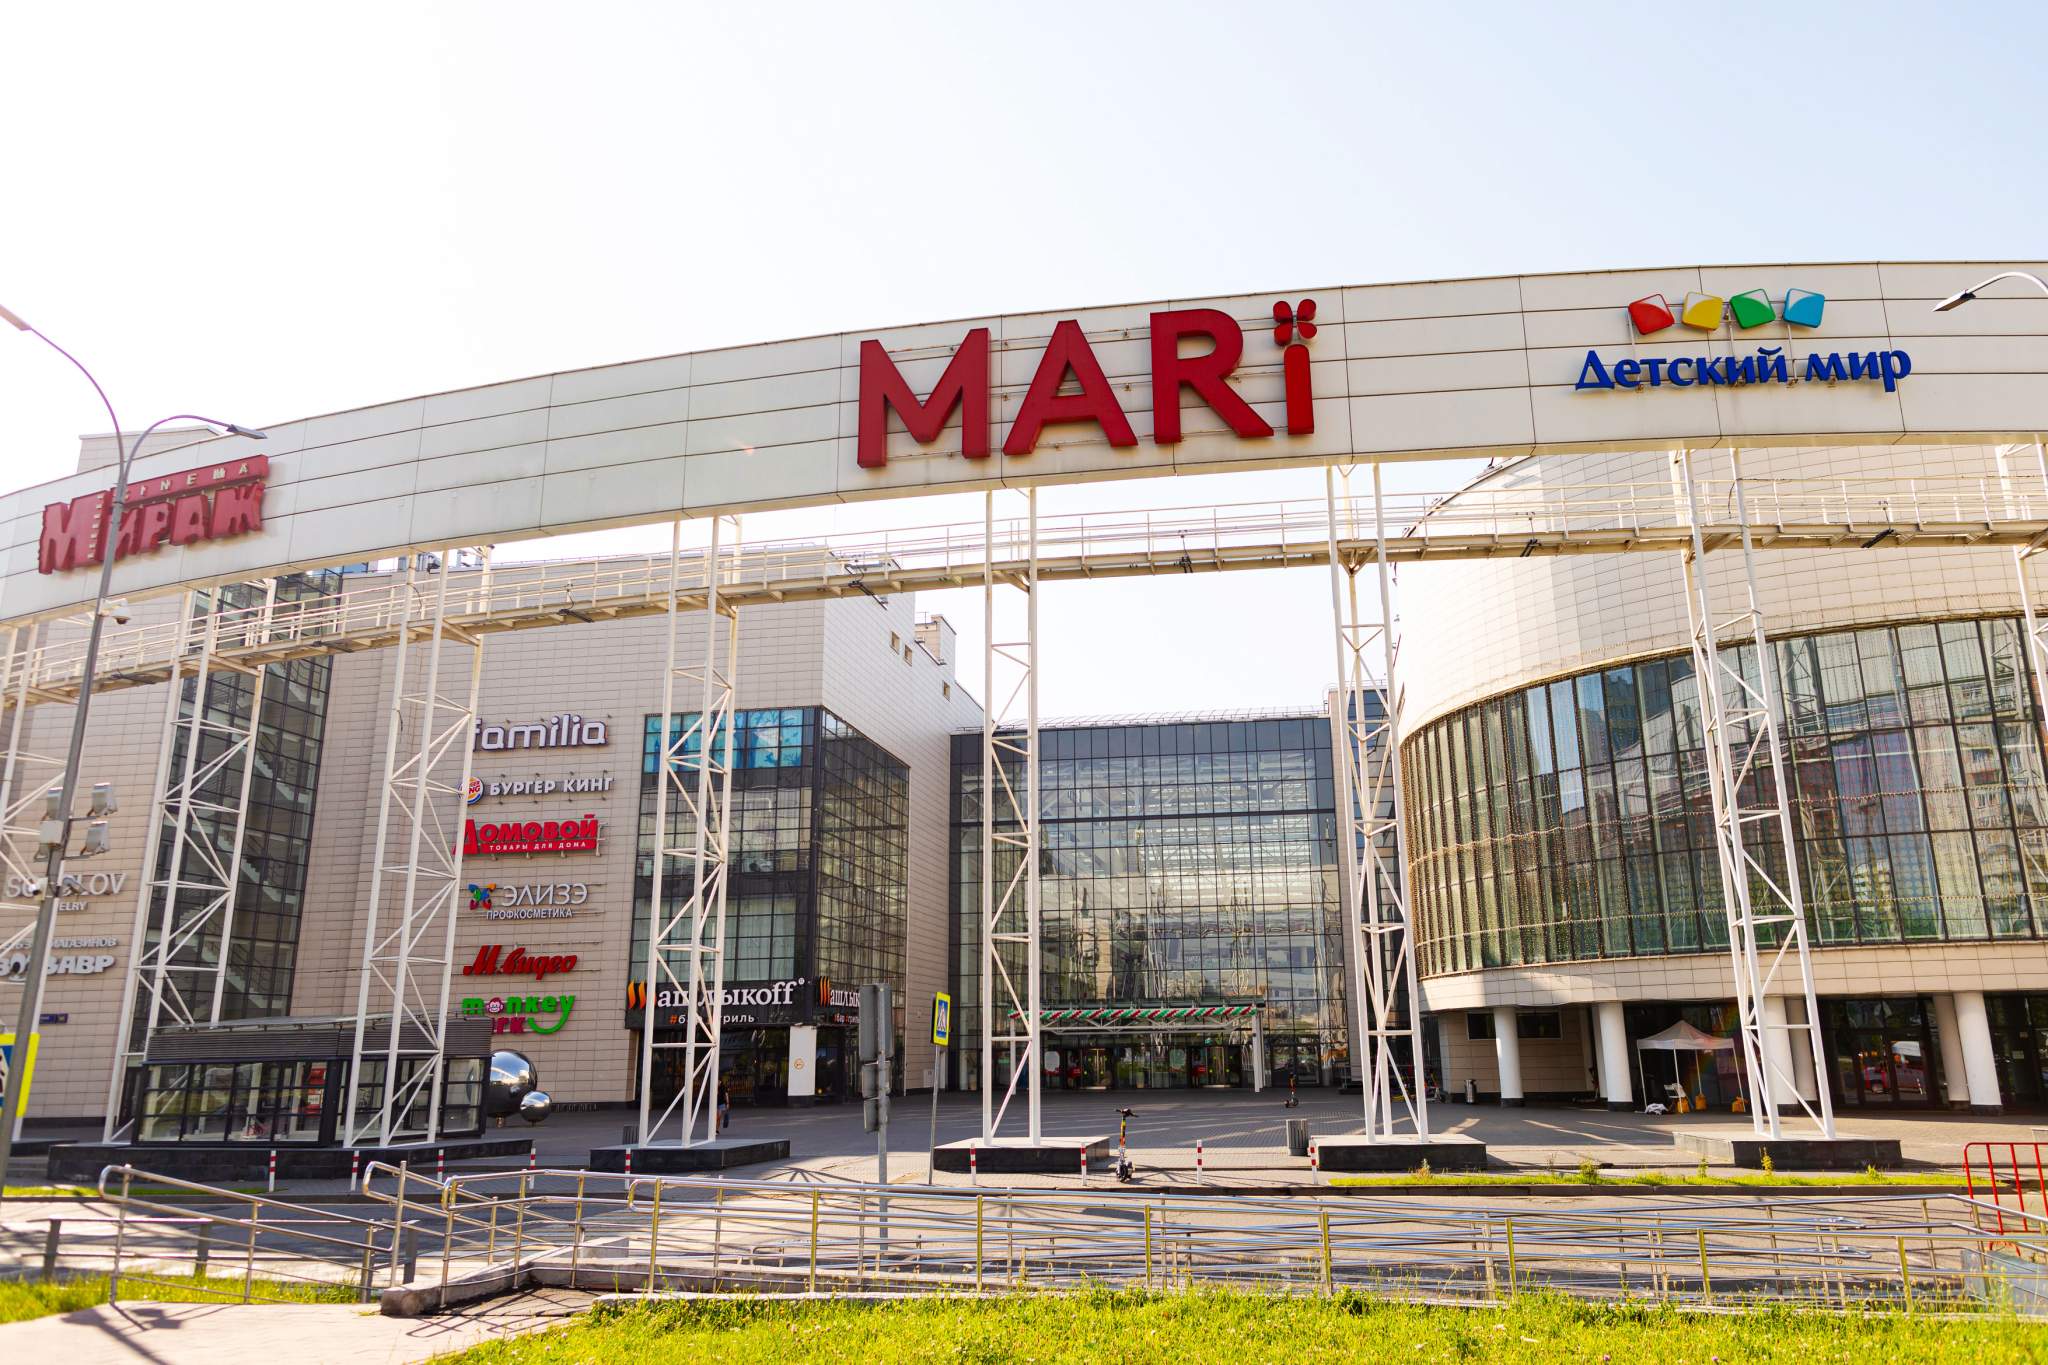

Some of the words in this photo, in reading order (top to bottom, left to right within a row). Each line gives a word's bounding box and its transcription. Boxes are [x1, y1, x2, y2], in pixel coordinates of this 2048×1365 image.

[1575, 345, 1788, 391] Детский
[1805, 349, 1912, 393] мир
[113, 462, 249, 501] INEMA
[473, 713, 609, 752] familia
[490, 780, 557, 797] БУРГЕР
[563, 777, 615, 793] КИНГ
[489, 844, 528, 852] ТОВАРЫ
[533, 843, 553, 851] ДЛЯ
[558, 841, 587, 850] ДОМА
[501, 883, 589, 907] ЭЛИЗЭ
[486, 908, 573, 921] ПРОФКОСМЕТИКА
